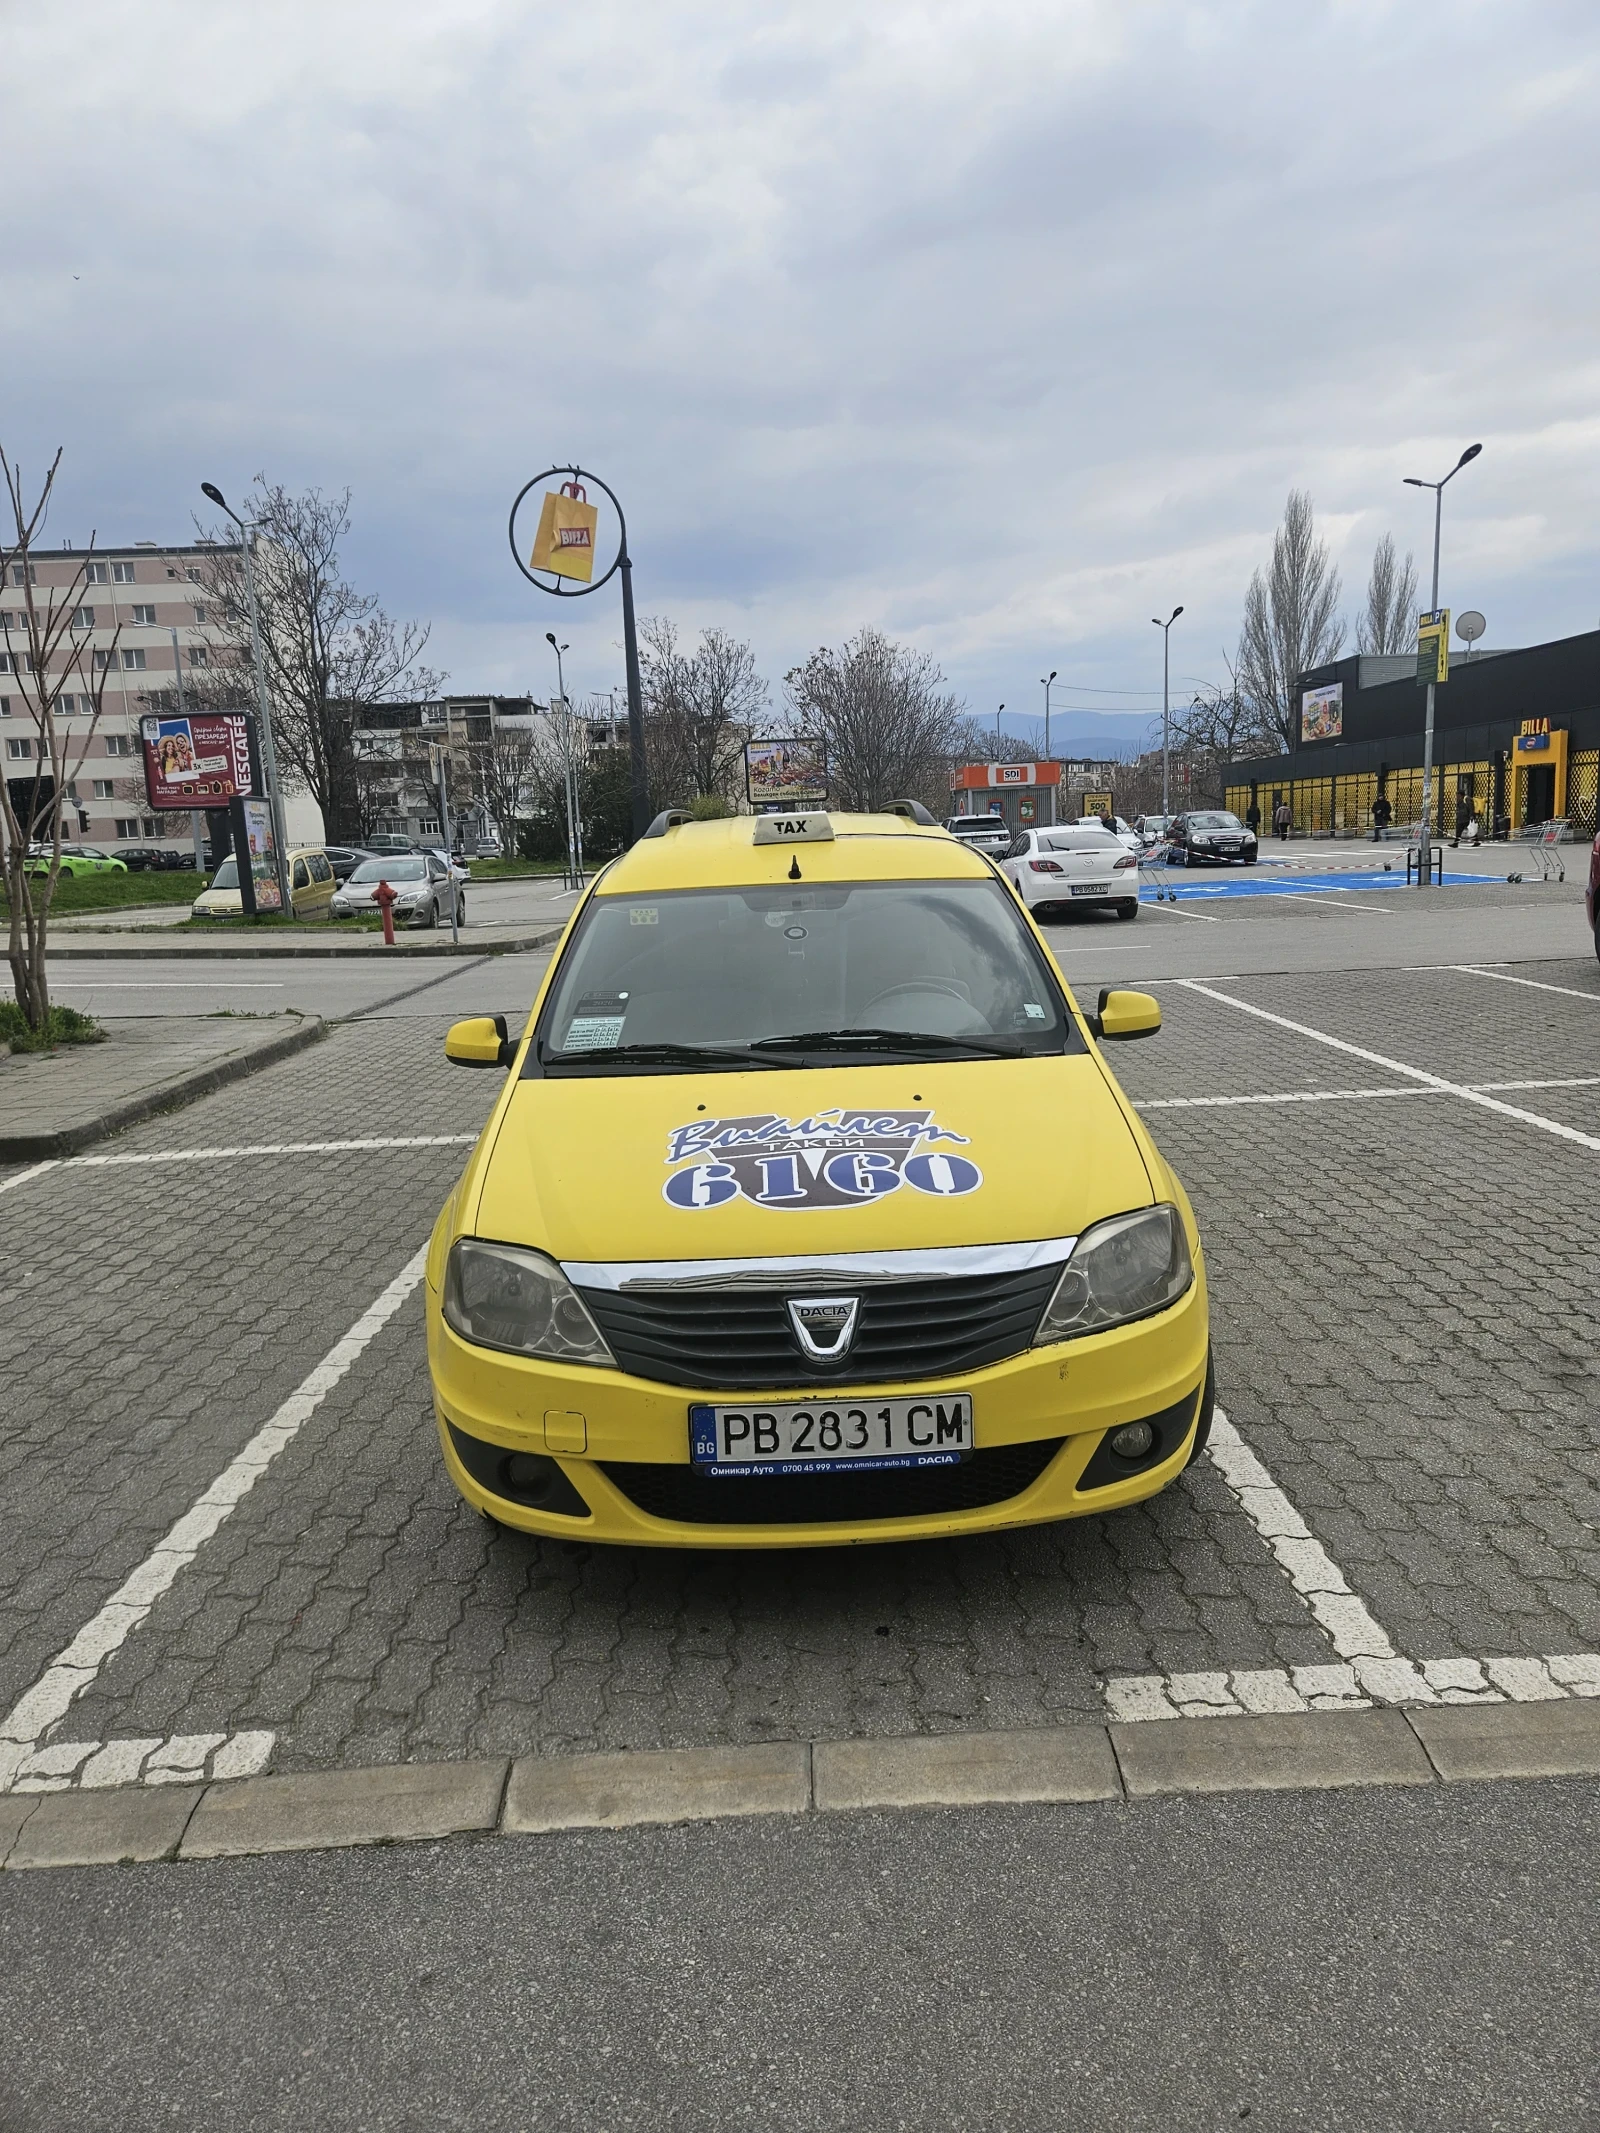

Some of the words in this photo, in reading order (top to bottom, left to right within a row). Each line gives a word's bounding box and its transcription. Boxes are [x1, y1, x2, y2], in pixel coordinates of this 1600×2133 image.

[560, 530, 590, 545] BILLA
[1421, 615, 1433, 626] BILLA
[1435, 612, 1440, 623] P
[1521, 718, 1549, 736] BILLA
[1004, 770, 1020, 778] SDI
[1090, 802, 1106, 810] 500
[763, 1138, 865, 1151] ТАКСИ
[664, 1152, 981, 1207] 6160
[800, 1306, 848, 1317] DACIA
[723, 1413, 780, 1455] PB
[790, 1407, 893, 1453] 2831
[907, 1403, 963, 1447] CM
[697, 1442, 715, 1455] BG
[711, 1467, 750, 1476] Омникар
[752, 1465, 774, 1475] Ауто
[782, 1465, 802, 1473] 0700
[816, 1463, 831, 1471] 999
[835, 1459, 910, 1469] www.omnicar-auto.bg
[918, 1455, 954, 1465] DACIA
